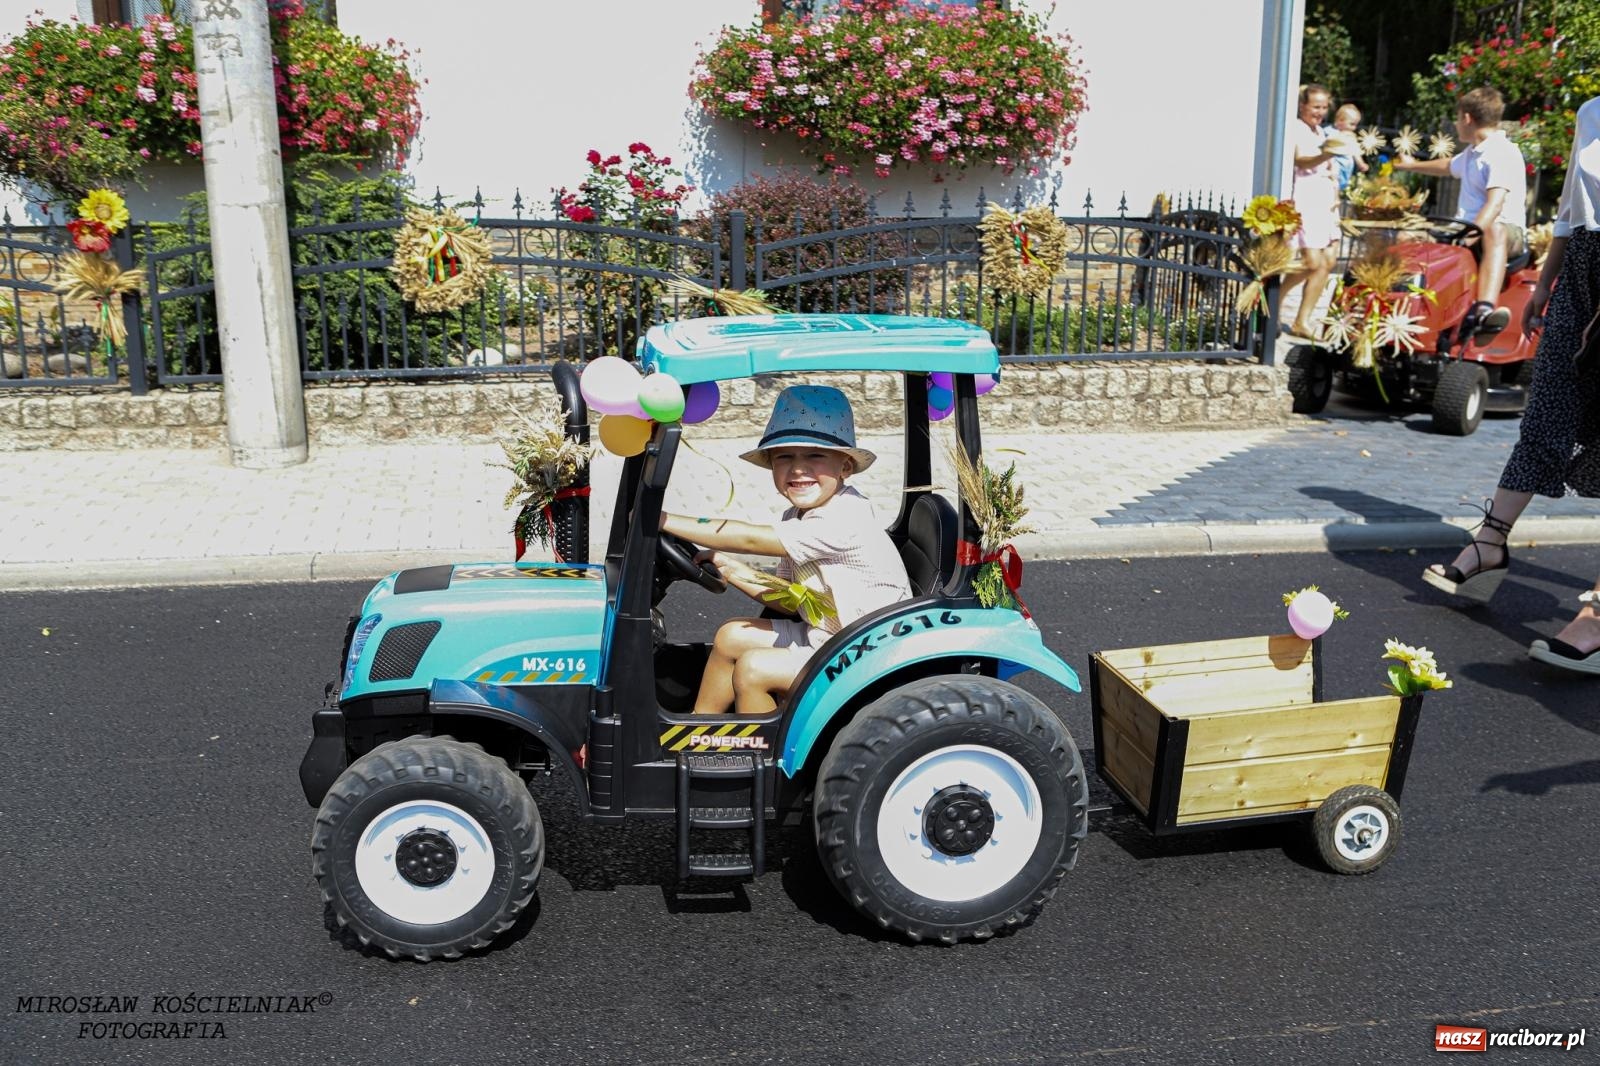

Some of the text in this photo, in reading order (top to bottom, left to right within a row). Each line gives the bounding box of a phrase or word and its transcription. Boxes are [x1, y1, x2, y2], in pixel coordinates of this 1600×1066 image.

[824, 610, 962, 683] MX-616
[522, 657, 586, 672] MX-616
[689, 734, 769, 749] POWERFUL
